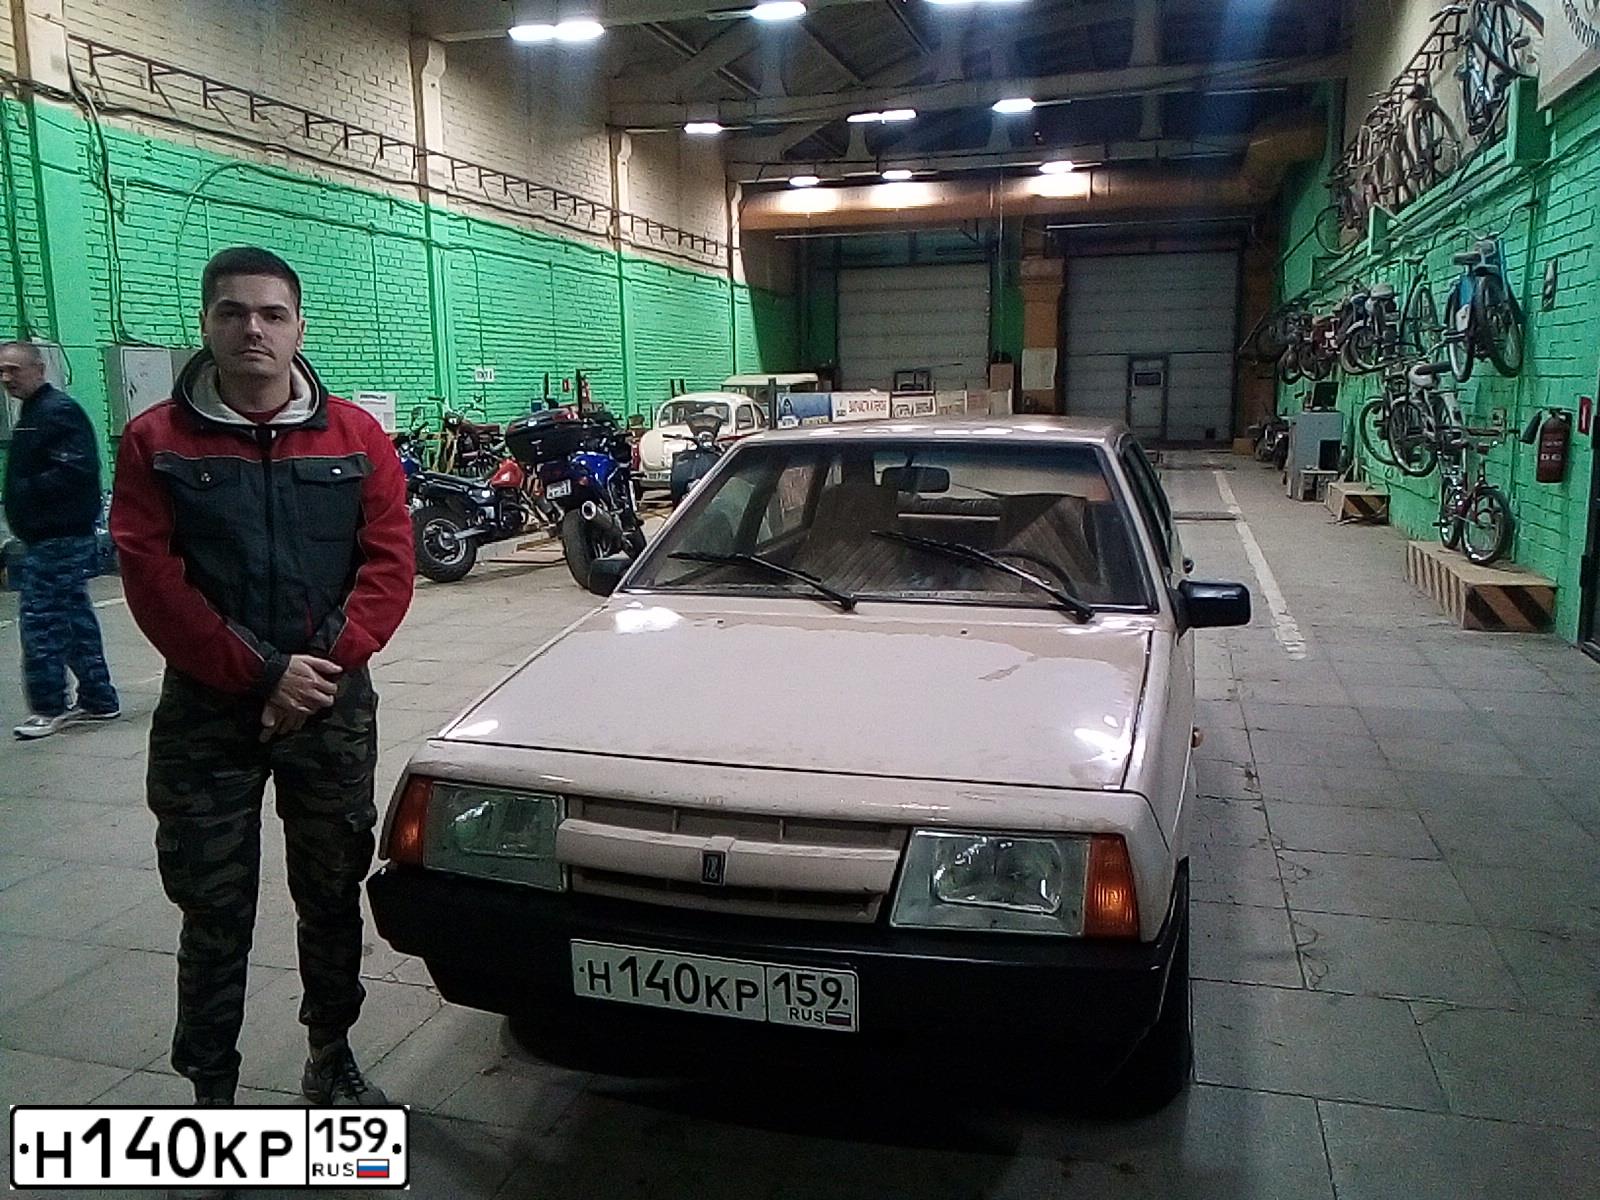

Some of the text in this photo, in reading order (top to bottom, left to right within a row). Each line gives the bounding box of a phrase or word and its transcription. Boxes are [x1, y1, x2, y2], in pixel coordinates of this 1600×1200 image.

[587, 955, 844, 1012] Н140КР 159
[788, 1008, 825, 1023] RUS
